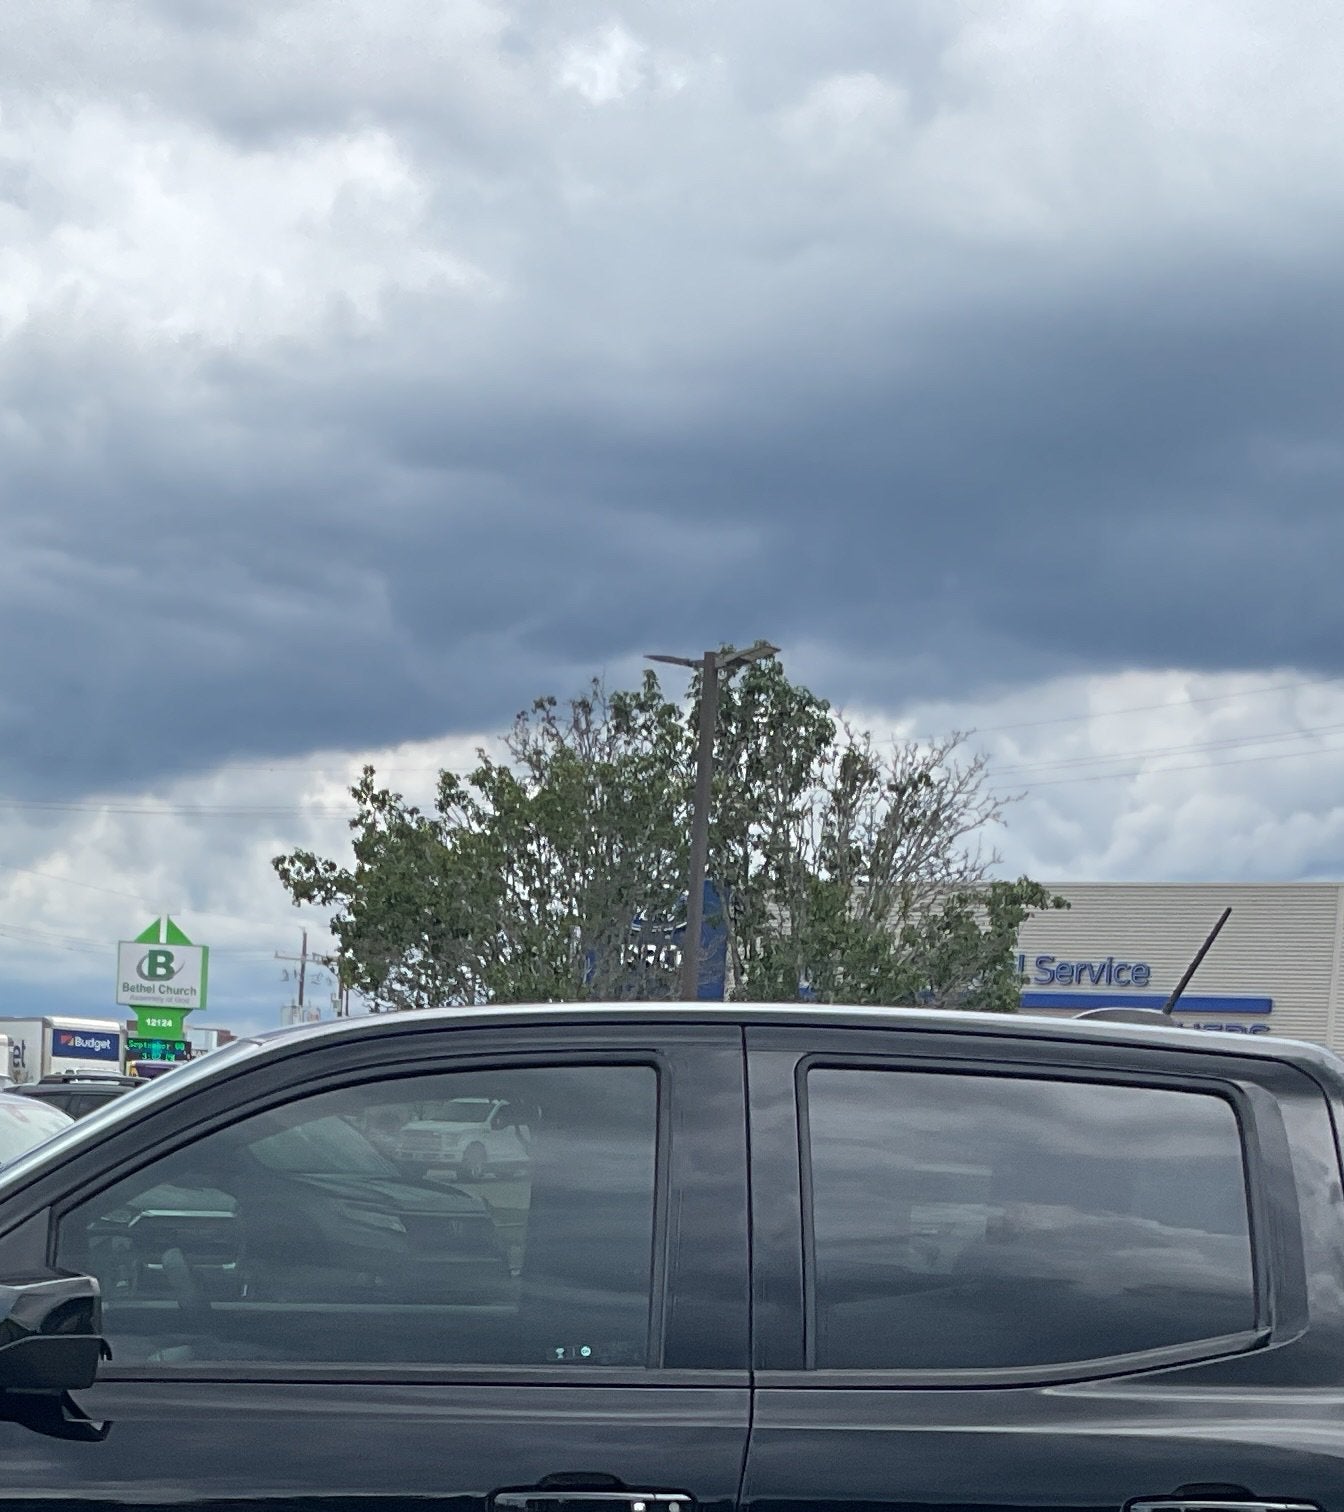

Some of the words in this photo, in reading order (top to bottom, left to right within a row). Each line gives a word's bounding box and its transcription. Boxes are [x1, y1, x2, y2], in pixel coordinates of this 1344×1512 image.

[1034, 955, 1151, 988] Service
[122, 982, 156, 994] Bethel
[158, 984, 197, 996] Church
[145, 1017, 173, 1027] 12124
[75, 1036, 111, 1052] Budget
